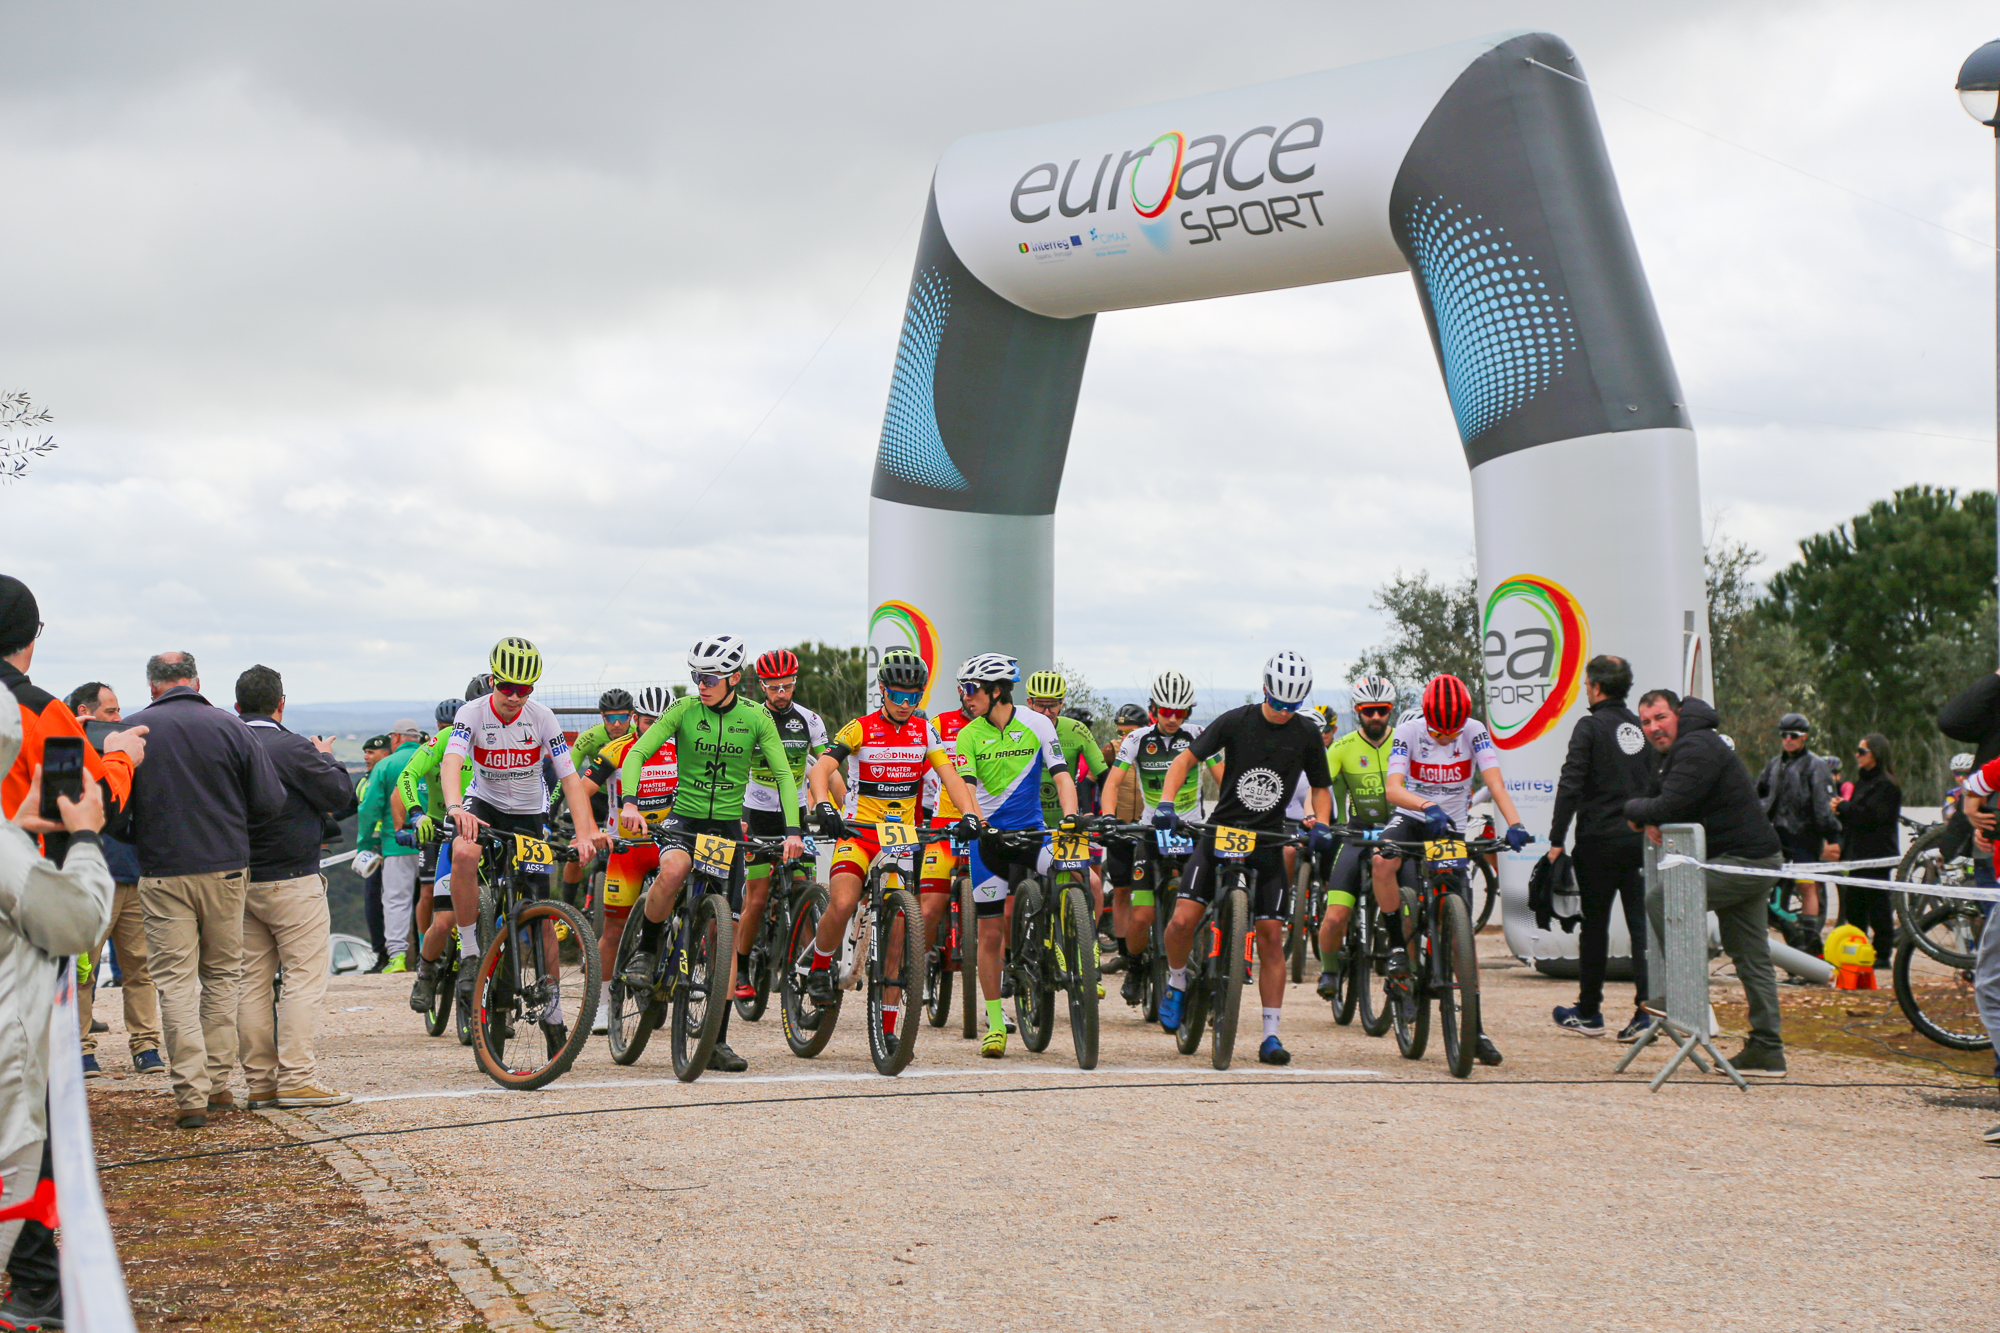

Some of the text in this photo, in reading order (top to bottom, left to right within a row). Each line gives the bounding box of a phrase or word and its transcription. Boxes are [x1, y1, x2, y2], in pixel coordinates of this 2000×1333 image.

[1010, 117, 1324, 223] euroace
[1180, 190, 1324, 245] SPORT
[450, 730, 470, 742] IKE
[454, 722, 471, 734] IBA
[694, 737, 744, 754] fundão
[1393, 738, 1408, 750] BA
[1474, 740, 1492, 753] BIK
[484, 751, 532, 768] ÁGUIAS
[1419, 765, 1462, 782] ÁGUIAS
[878, 784, 911, 792] Benecar
[1503, 778, 1553, 793] nterreg
[637, 797, 667, 805] enecar
[823, 803, 835, 816] FOX
[885, 825, 908, 845] 51
[1224, 831, 1248, 852] 58
[523, 838, 545, 863] 53
[700, 838, 728, 865] 55
[891, 845, 905, 853] ACS
[1058, 836, 1081, 860] 52
[526, 864, 540, 872] ACS
[701, 862, 715, 874] ACS
[474, 1008, 484, 1050] MAXXIS
